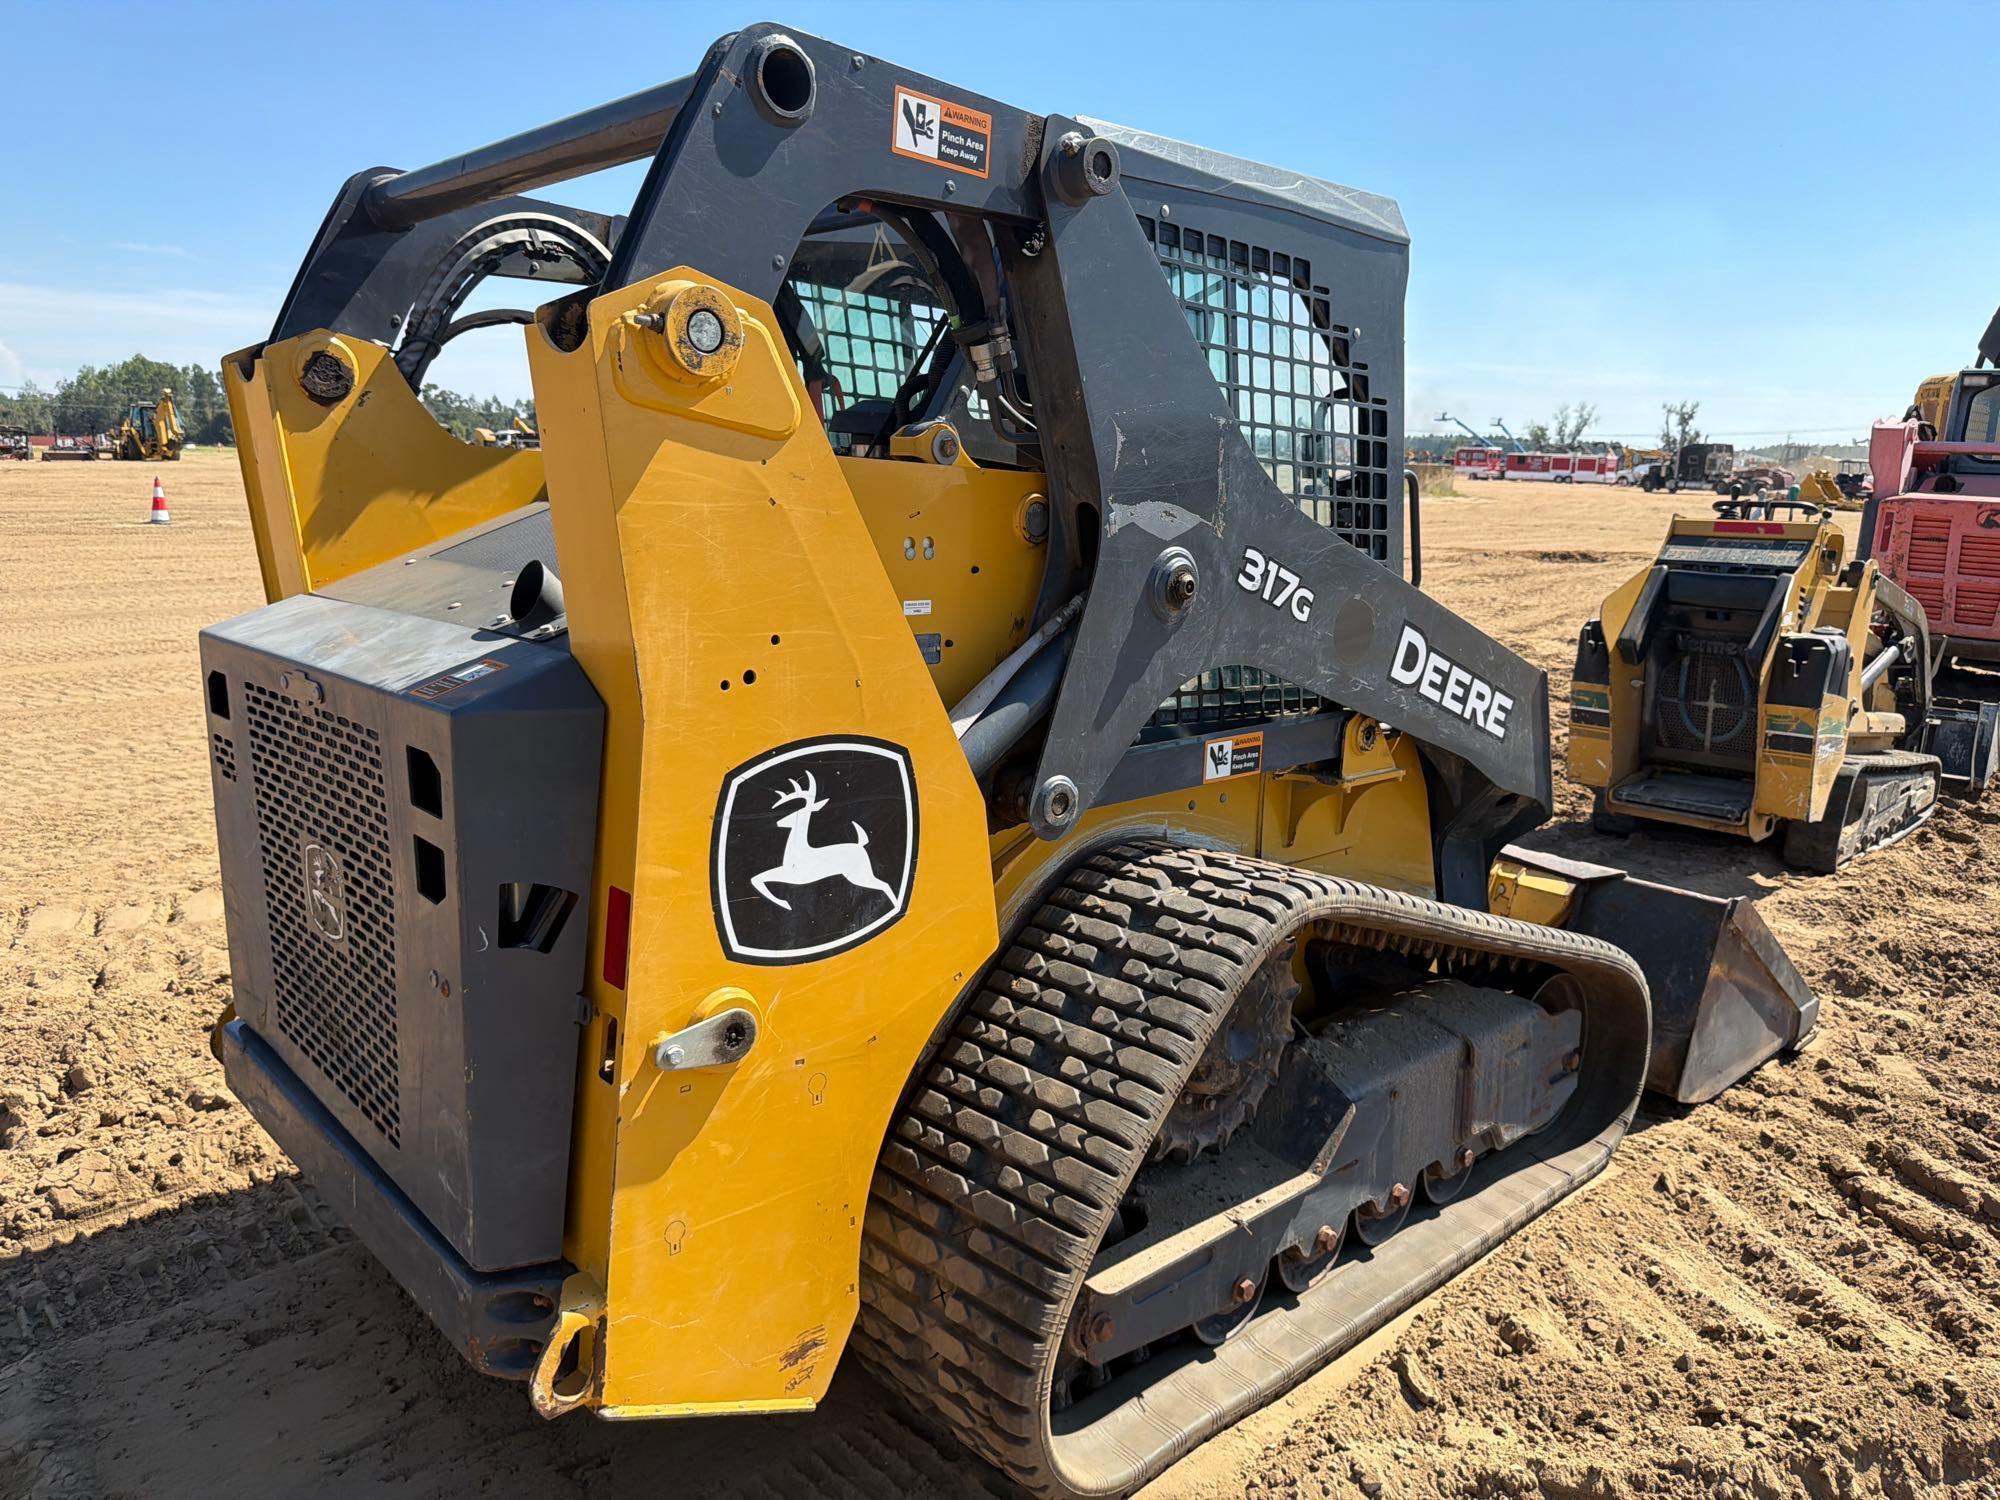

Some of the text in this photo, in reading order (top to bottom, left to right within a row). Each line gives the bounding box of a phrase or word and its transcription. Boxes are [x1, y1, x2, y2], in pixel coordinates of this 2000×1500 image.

[952, 110, 987, 129] WARNING
[941, 130, 984, 152] Pinch Area
[941, 144, 978, 164] Keep Away
[1237, 548, 1315, 622] 317G
[1390, 625, 1514, 739] DEERE
[1239, 735, 1260, 745] WARNING
[1232, 753, 1247, 761] Pinch
